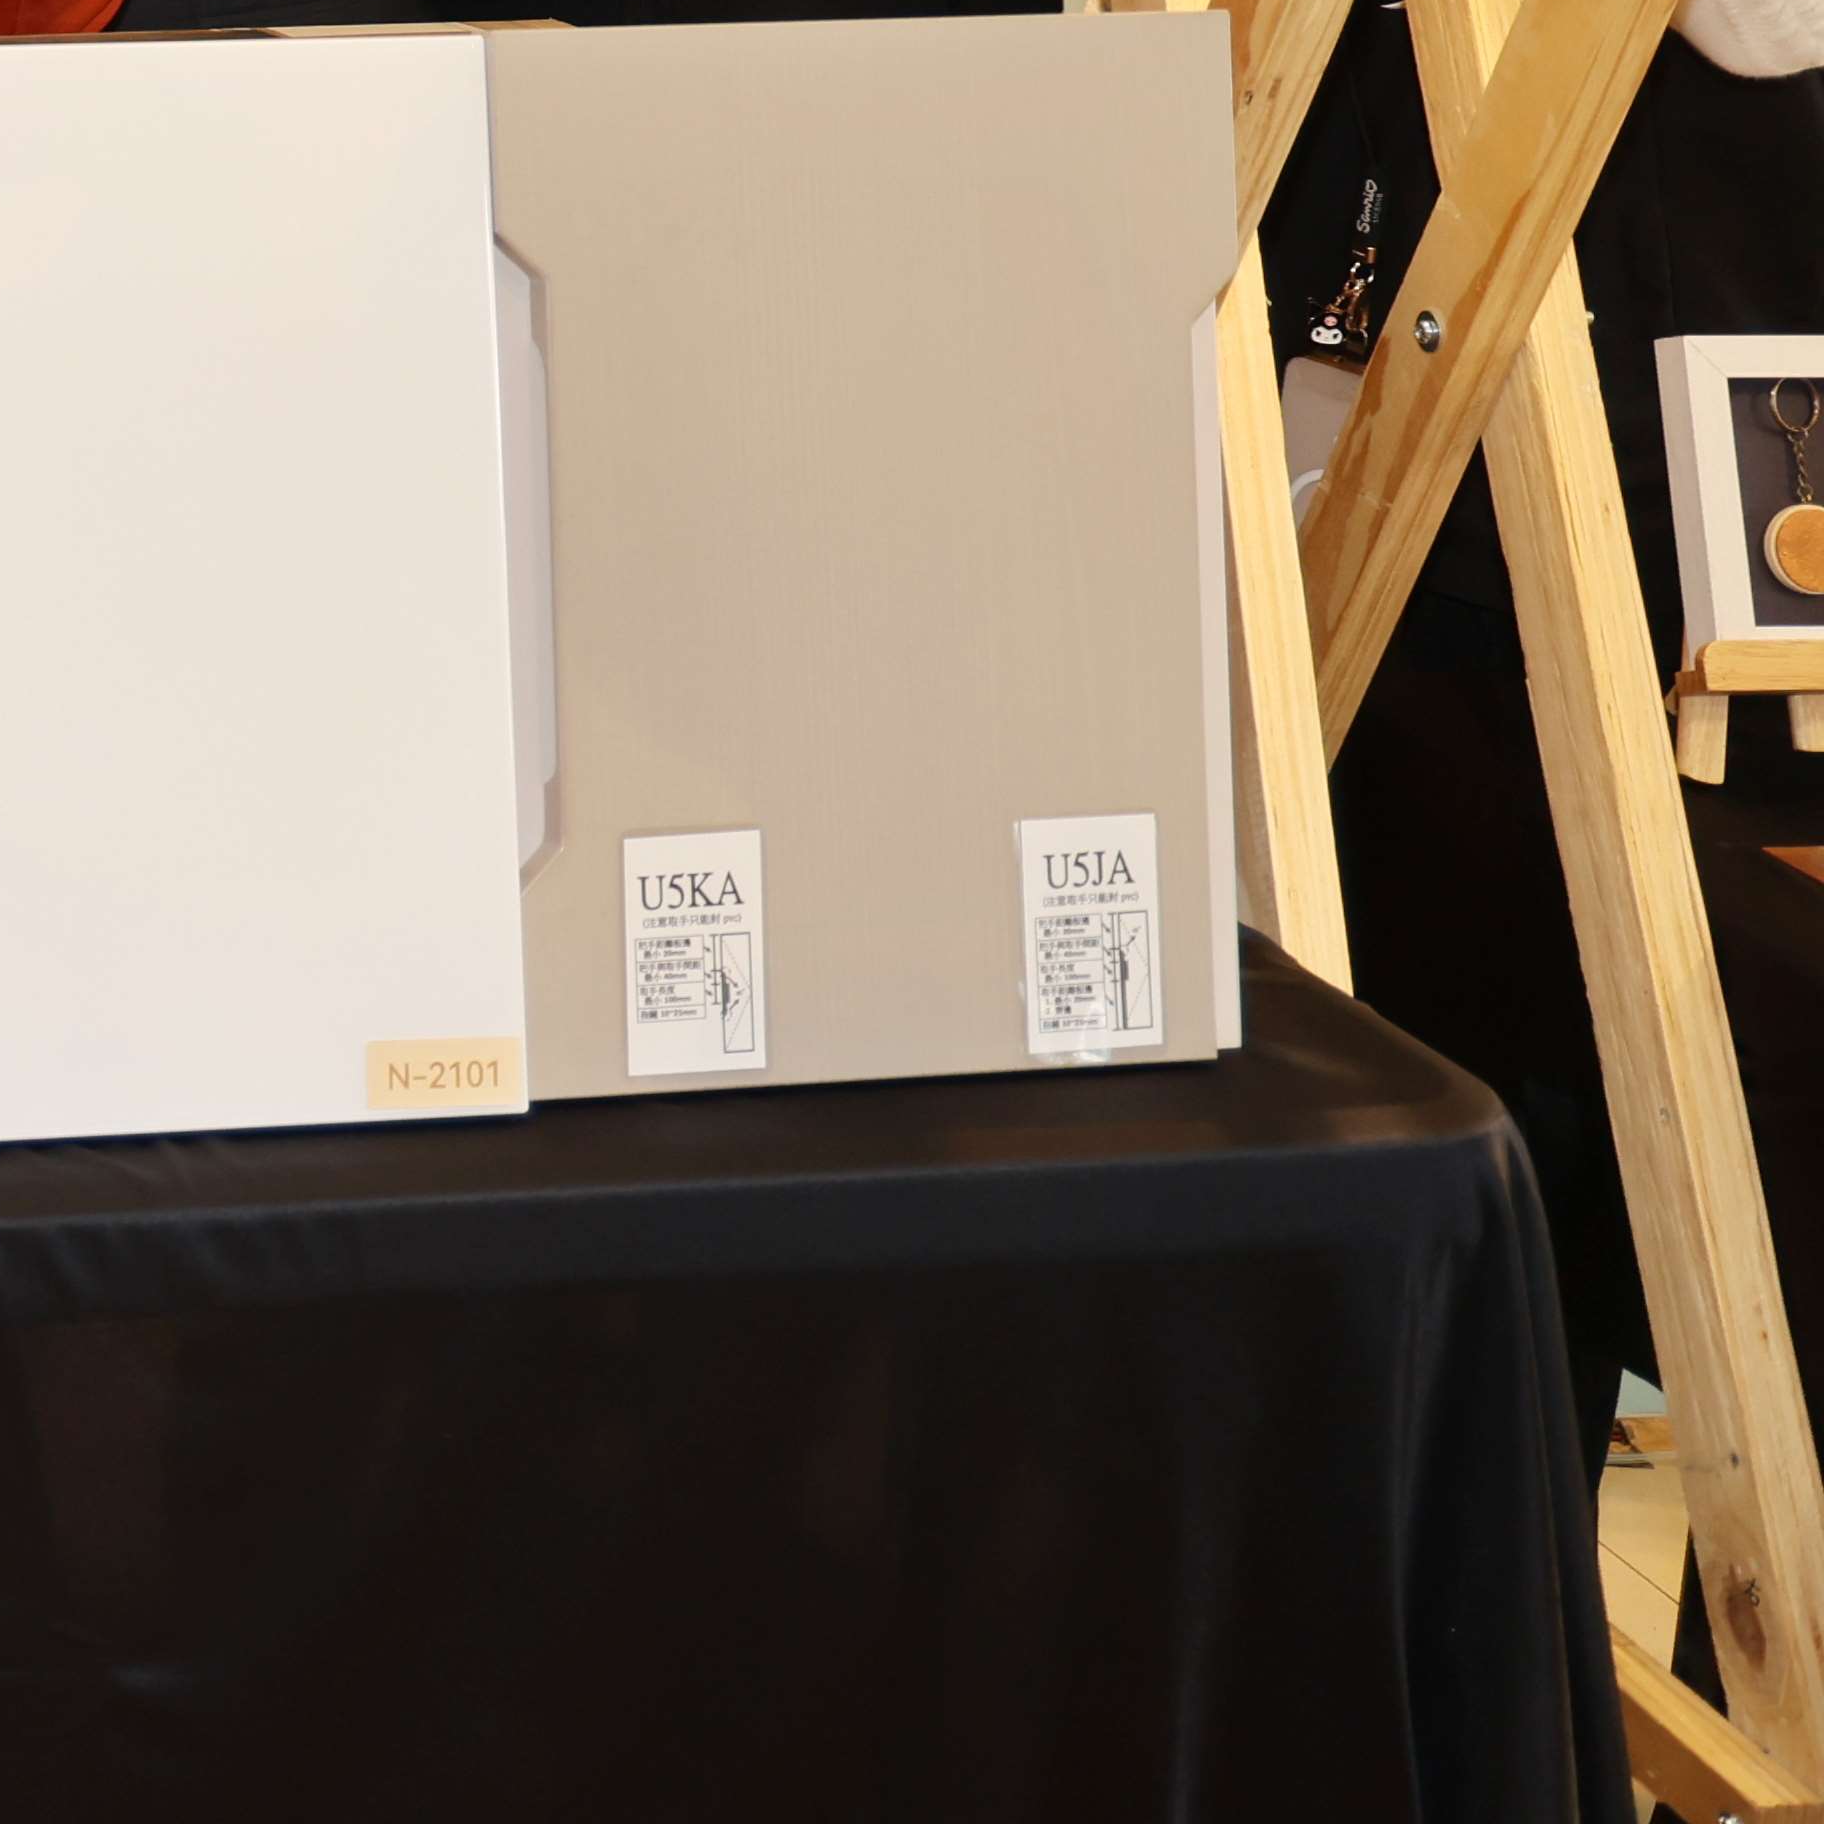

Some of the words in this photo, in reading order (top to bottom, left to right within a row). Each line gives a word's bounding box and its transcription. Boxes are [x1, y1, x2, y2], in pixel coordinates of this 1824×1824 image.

[1043, 850, 1135, 889] U5JA
[637, 871, 744, 911] U5KA
[388, 1060, 499, 1088] N-2101
